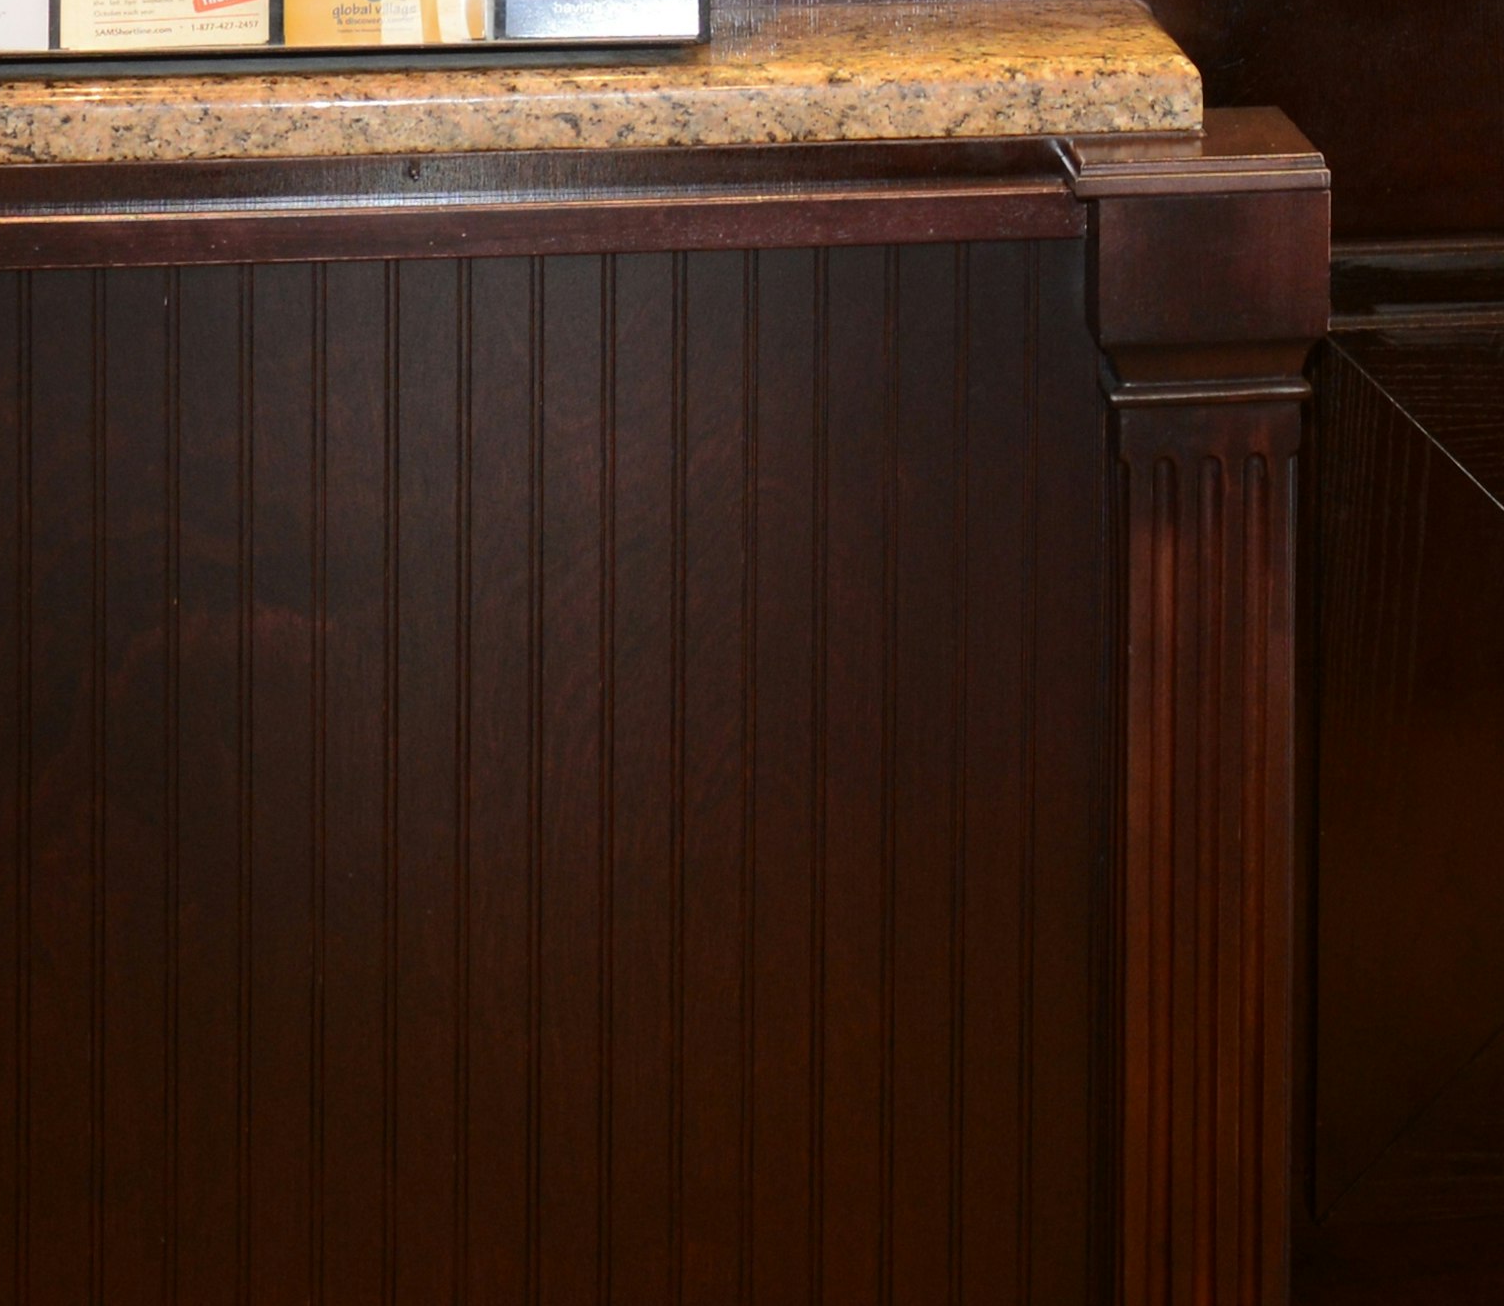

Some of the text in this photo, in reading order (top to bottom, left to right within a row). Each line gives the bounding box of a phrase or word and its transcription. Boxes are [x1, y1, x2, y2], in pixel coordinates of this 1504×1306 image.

[332, 3, 372, 19] global
[191, 20, 259, 33] 1-877-427-2457
[346, 17, 384, 26] discover
